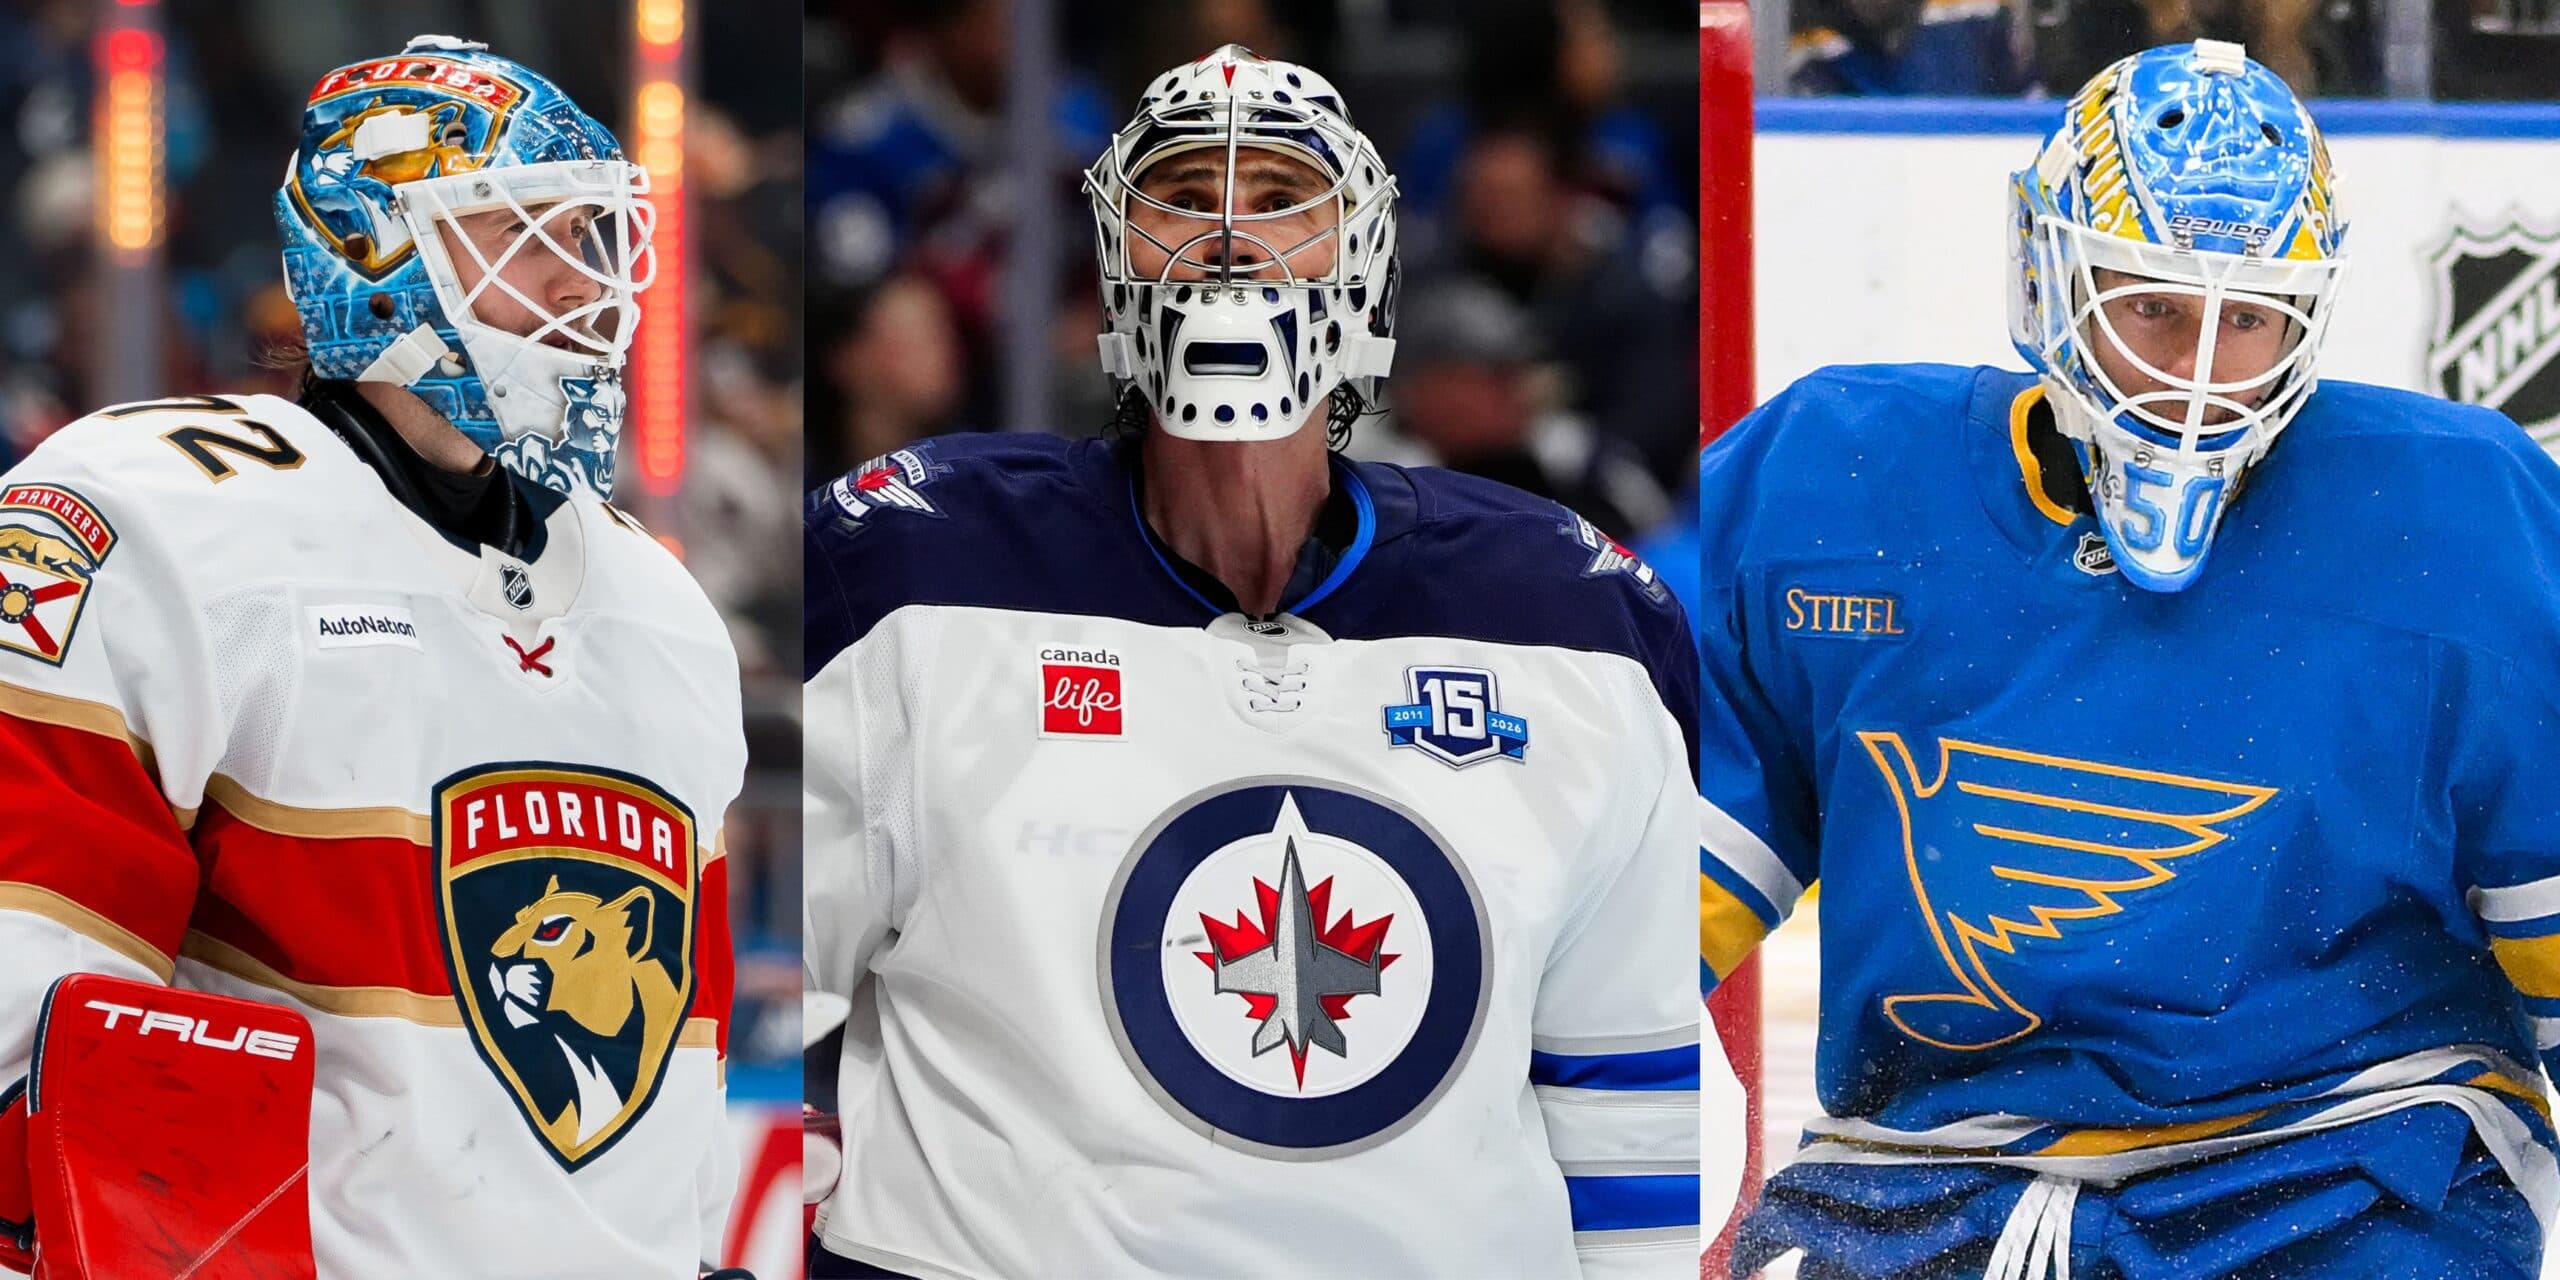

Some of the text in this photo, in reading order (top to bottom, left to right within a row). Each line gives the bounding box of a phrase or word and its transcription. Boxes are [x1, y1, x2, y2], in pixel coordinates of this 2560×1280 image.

[2459, 272, 2560, 405] NHL
[14, 490, 101, 544] PANTHERS
[2121, 461, 2226, 560] 50
[509, 576, 526, 600] NHL
[1786, 588, 1905, 635] STIFEL
[319, 616, 417, 639] AutoNation
[1040, 649, 1120, 667] canada
[1044, 676, 1121, 727] life
[1394, 709, 1423, 721] 2011
[1422, 678, 1486, 739] 15
[1491, 718, 1522, 733] 2026
[466, 790, 674, 870] FLORIDA
[84, 1000, 301, 1061] TRUE
